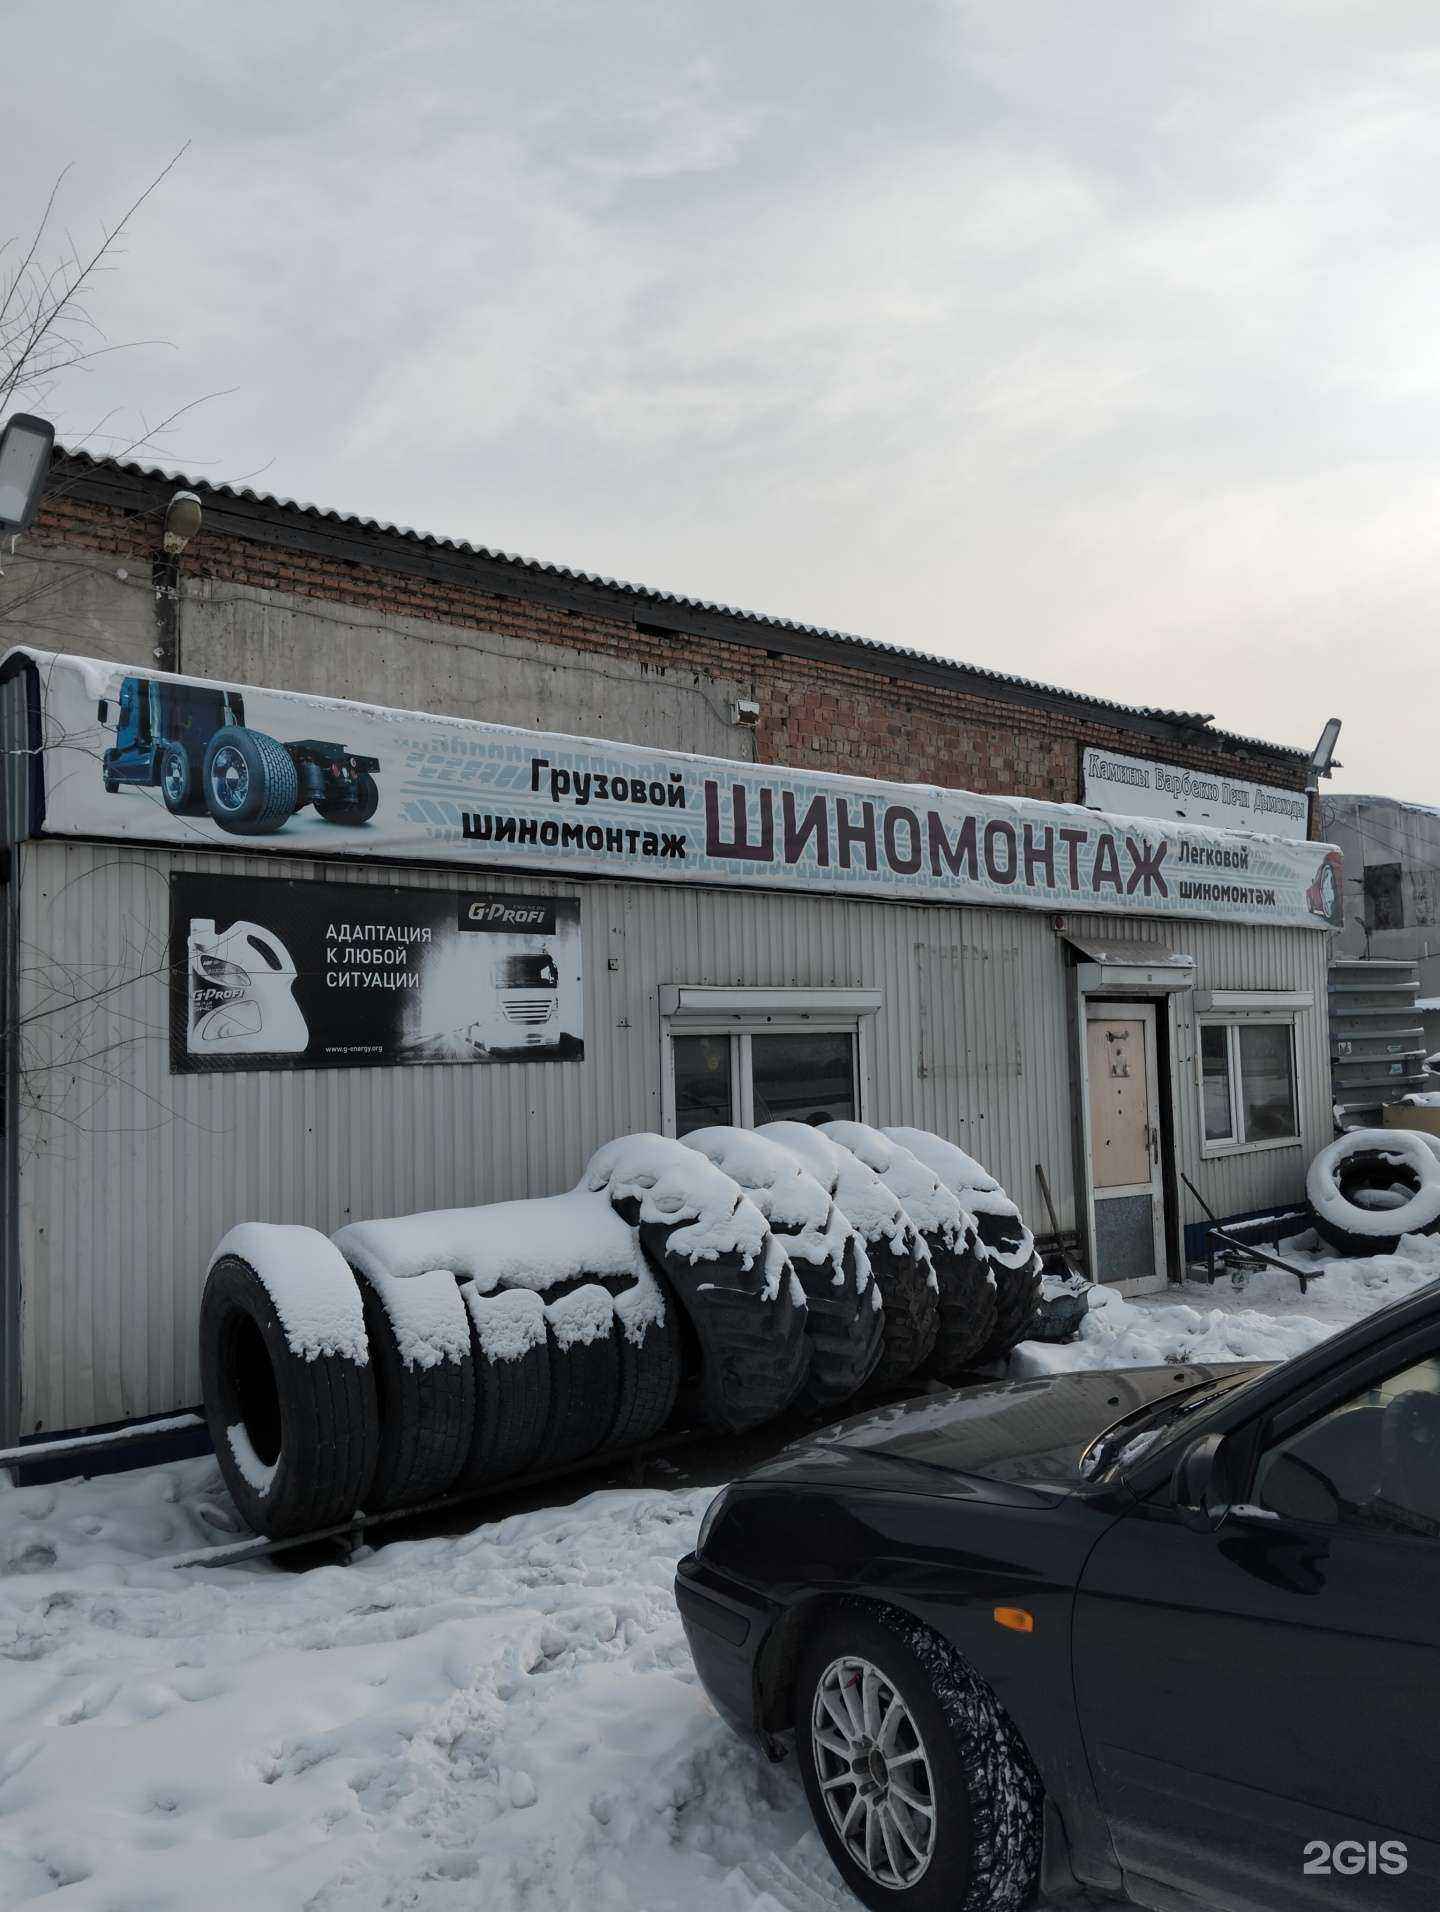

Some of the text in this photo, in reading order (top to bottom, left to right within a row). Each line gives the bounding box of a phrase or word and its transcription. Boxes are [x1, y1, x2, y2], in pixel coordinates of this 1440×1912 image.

[531, 758, 686, 809] Грузовой
[1088, 753, 1150, 788] Камины
[1154, 767, 1220, 801] Барбекю
[1221, 782, 1250, 808] Печи
[462, 812, 687, 859] шиномонтаж
[704, 780, 1169, 898] ШИНОМОНТАЖ
[1178, 840, 1249, 870] Легковой
[1179, 881, 1276, 906] шиномонтаж
[326, 923, 432, 945] АДАПТАЦИЯ
[326, 946, 407, 965] К ЛЮБОЙ
[326, 971, 419, 990] СИТУАЦИИ
[325, 1045, 383, 1054] www.g-energy.org
